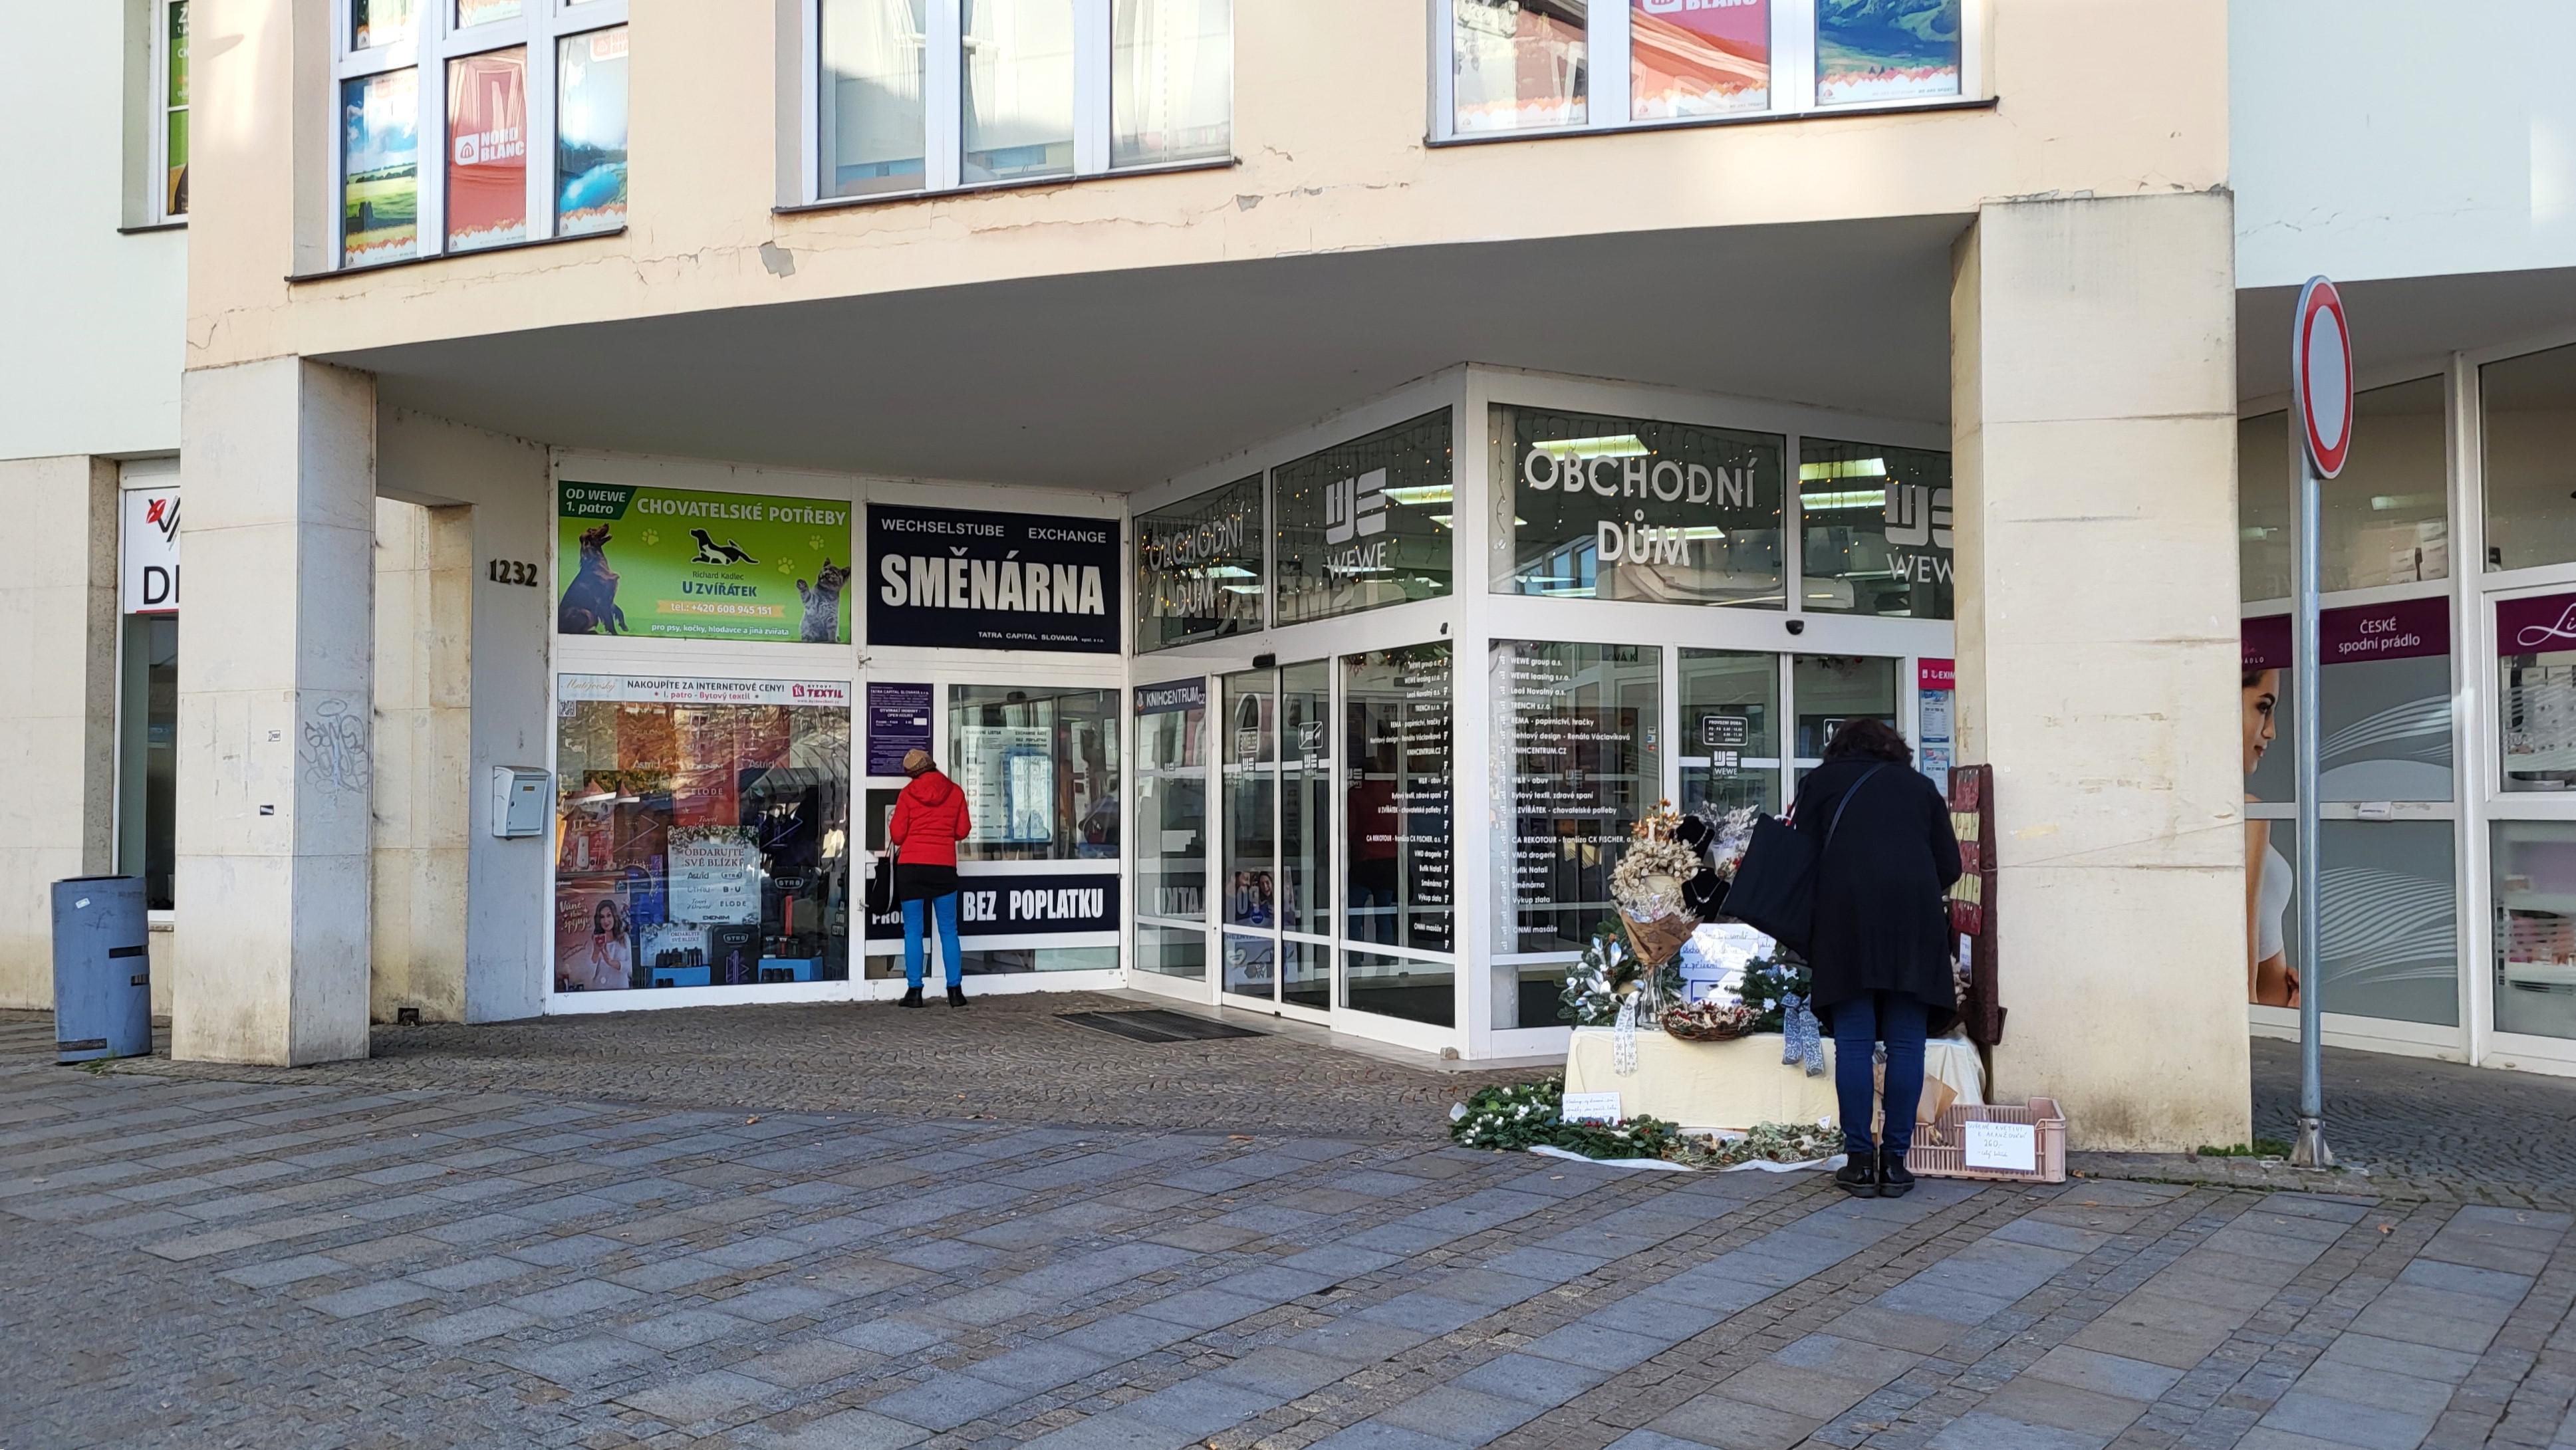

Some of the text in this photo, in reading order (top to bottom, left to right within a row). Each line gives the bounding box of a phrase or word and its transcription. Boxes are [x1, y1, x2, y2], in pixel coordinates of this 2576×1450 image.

[481, 141, 525, 162] BLANC
[1524, 447, 1758, 509] OBCHODNÍ
[565, 487, 626, 503] OD WEWE
[566, 501, 614, 515] 1. patro
[637, 497, 846, 526] CHOVATELSKÉ POTŘEBY
[881, 519, 1106, 544] WECHSELSTUBE EXCHANGE
[1149, 501, 1245, 570] OBCHODNÍ
[1598, 509, 1690, 568] DŮM
[1327, 541, 1387, 581] WEWE
[1885, 553, 1954, 584] WEW
[489, 558, 538, 586] 1232
[880, 546, 1105, 615] SMĚNÁRNA
[682, 581, 757, 597] U ZVÍŘÁTEK
[671, 603, 688, 612] tel.:
[717, 604, 735, 614] 608
[737, 606, 755, 614] 945
[758, 606, 771, 615] 151
[684, 624, 707, 633] kočky,
[709, 626, 741, 634] hlodavce
[2360, 616, 2396, 634] ČESKÉ
[2339, 633, 2420, 654] spodní prádlo
[1531, 672, 1554, 681] leasing
[627, 679, 680, 689] NAKOUPÍTE
[696, 681, 756, 691] INTERNETOVÉ
[759, 683, 785, 692] CENY!
[700, 692, 726, 701] Bytový
[807, 689, 844, 699] TEXTIL
[1572, 718, 1594, 727] hračky
[1540, 732, 1561, 741] design
[1591, 732, 1630, 741] Václavíková
[749, 760, 775, 769] Astrid
[1577, 791, 1593, 800] spaní
[684, 848, 745, 857] OBDARUJTE
[963, 888, 1103, 921] BEZ POPLATKU
[1513, 896, 1533, 905] Výkup
[872, 911, 905, 925] PRO
[1533, 925, 1558, 933] masáže
